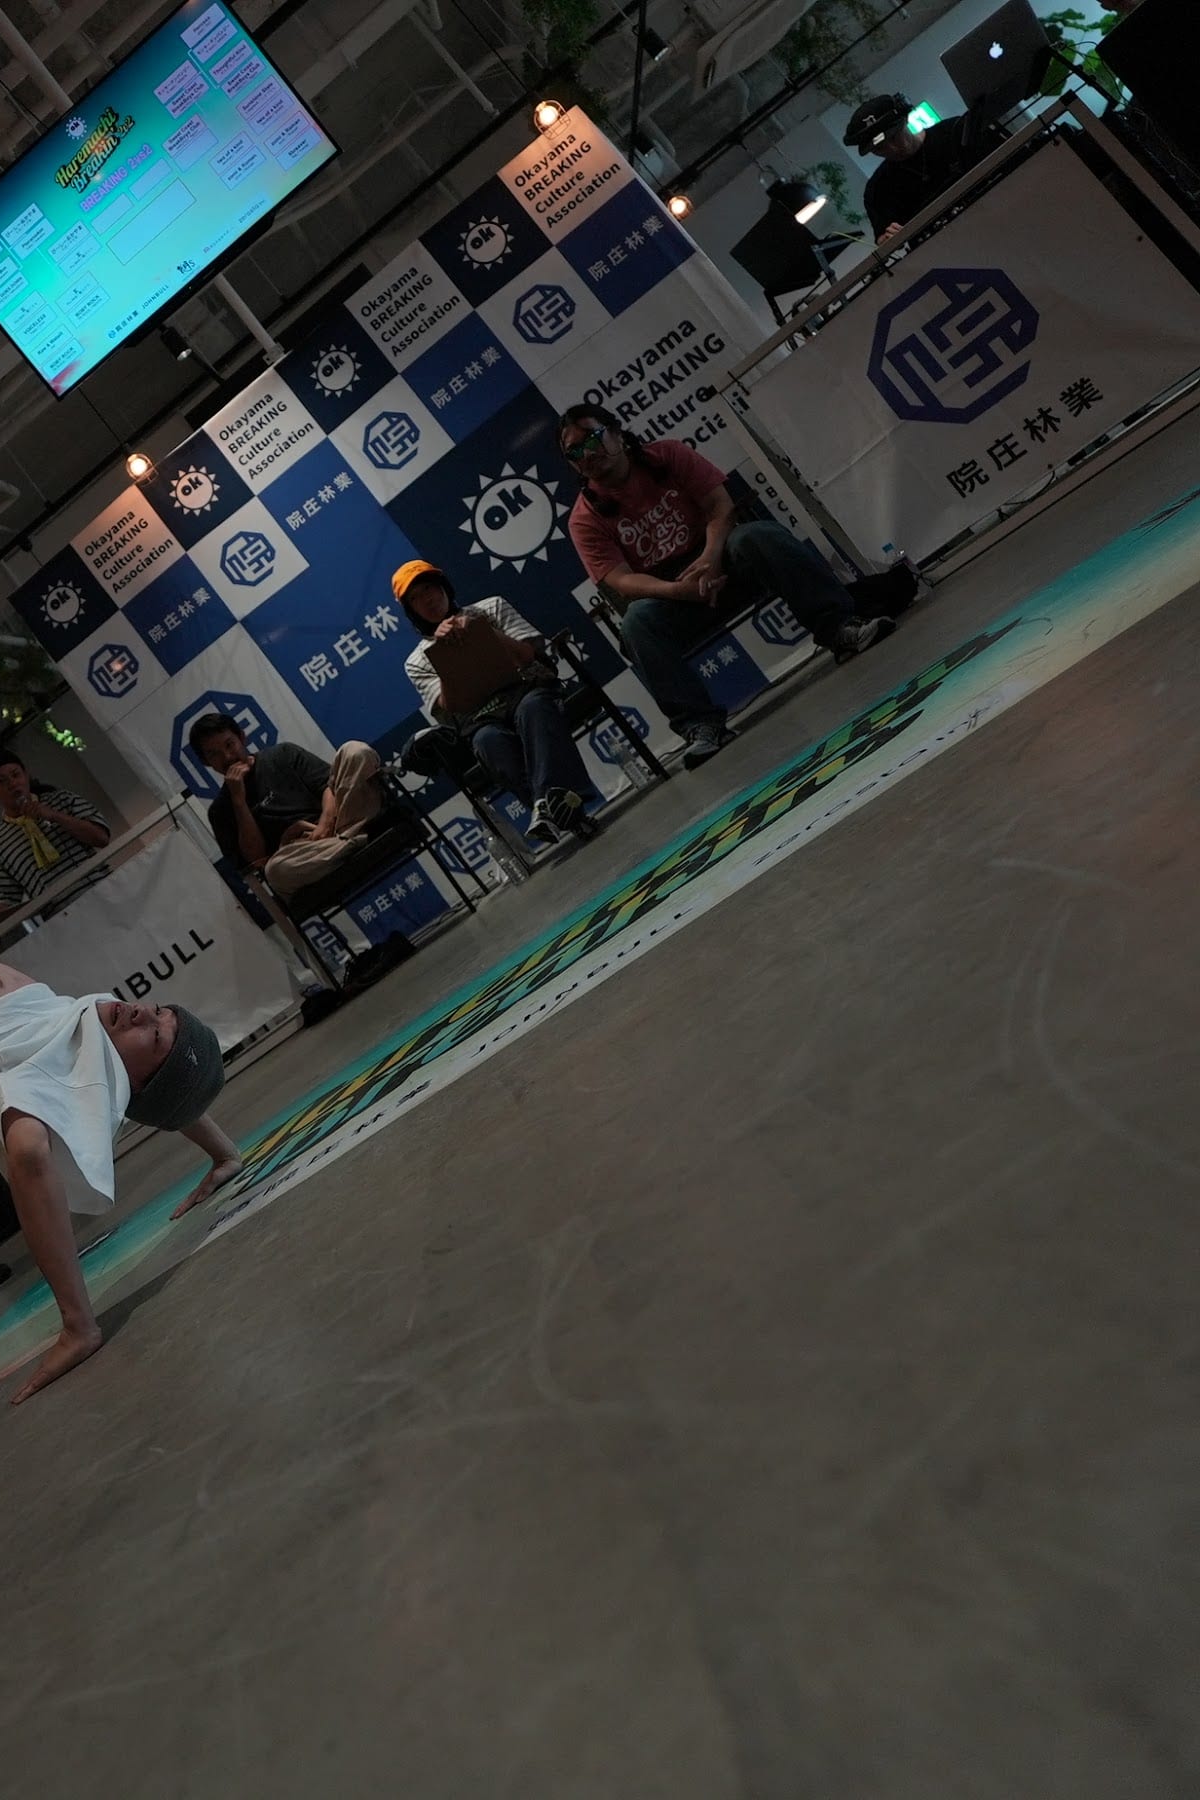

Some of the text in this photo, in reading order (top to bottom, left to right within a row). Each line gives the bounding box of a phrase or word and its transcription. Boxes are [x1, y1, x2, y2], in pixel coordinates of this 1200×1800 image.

[55, 107, 118, 189] Haremachi
[514, 132, 577, 188] Okayama
[523, 140, 592, 202] BREAKING
[80, 172, 127, 212] BREAKING
[535, 169, 585, 214] Culture
[544, 161, 621, 228] Association
[587, 214, 665, 282] 院庄林業
[360, 265, 419, 318] Okayama
[370, 273, 434, 331] BREAKING
[380, 301, 427, 344] Culture
[390, 294, 462, 357] Association
[430, 345, 503, 410] 院庄林業
[583, 317, 698, 407] Okayama
[219, 392, 274, 442] Okayama
[228, 401, 288, 455] BREAKING
[635, 384, 714, 446] ulture
[945, 376, 1105, 499] 院庄林業
[238, 426, 282, 467] Culture
[247, 421, 315, 480] Association
[285, 471, 354, 531] 院庄林業
[483, 484, 534, 530] ok
[84, 510, 136, 557] Okayama
[92, 518, 149, 569] BREAKING
[102, 542, 145, 581] Culture
[111, 537, 173, 593] Association
[147, 587, 212, 643] 院庄林業
[298, 604, 402, 693] 院庄林
[698, 644, 740, 680] 林業
[357, 868, 426, 924] 院庄林業
[470, 908, 693, 1058] JOHNBULL
